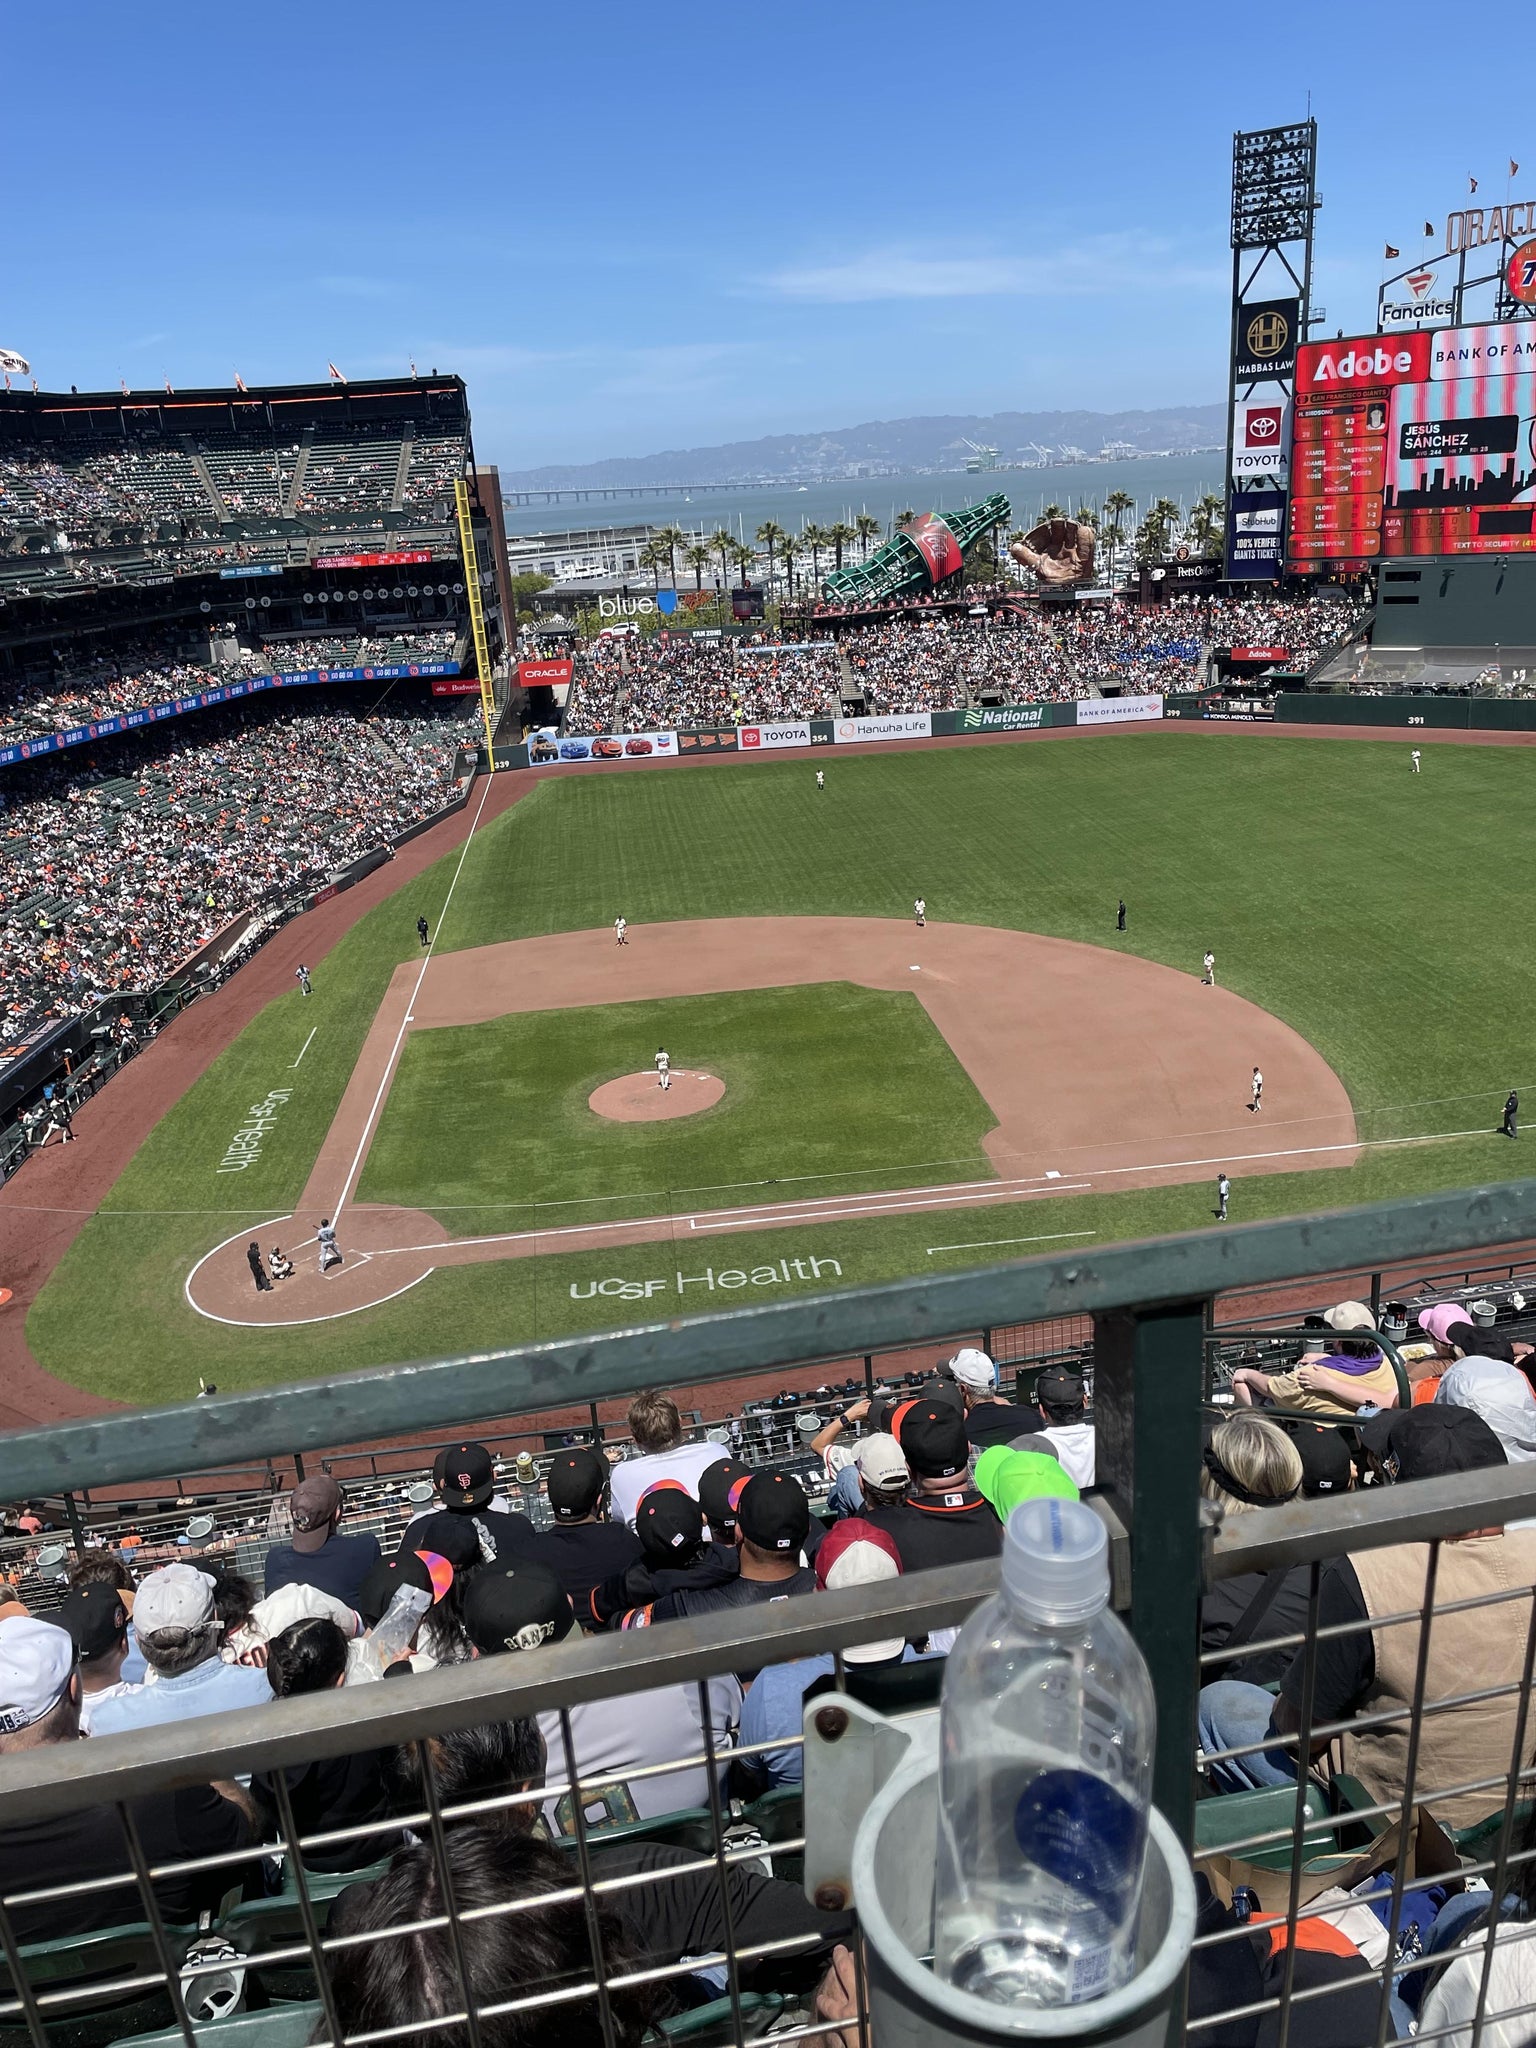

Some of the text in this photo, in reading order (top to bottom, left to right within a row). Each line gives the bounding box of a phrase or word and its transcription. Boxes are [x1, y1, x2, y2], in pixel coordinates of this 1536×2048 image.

[1522, 260, 1536, 287] 7
[1382, 300, 1453, 321] Fanatics
[1436, 347, 1481, 362] BANK
[1487, 344, 1508, 356] OF
[1238, 360, 1294, 374] HABBAS LAW
[1313, 348, 1412, 381] Adobe
[1405, 422, 1440, 435] JESÚS
[1405, 434, 1468, 449] SÁNCHEZ
[1236, 454, 1288, 468] TOYOTA
[1242, 516, 1276, 526] StubHub
[1236, 537, 1280, 548] 100% VERIFIED
[1234, 549, 1281, 560] GIANTS TICKETS
[1195, 565, 1214, 576] Coffee
[598, 594, 653, 617] blue
[525, 668, 568, 678] ORACLE
[983, 708, 1043, 724] National
[858, 721, 926, 734] Hanwha Life
[1017, 721, 1040, 729] Rental
[764, 730, 807, 741] TOYOTA
[494, 761, 510, 769] 339
[216, 1088, 294, 1173] UCSF Health
[570, 1256, 843, 1300] UCSF Health
